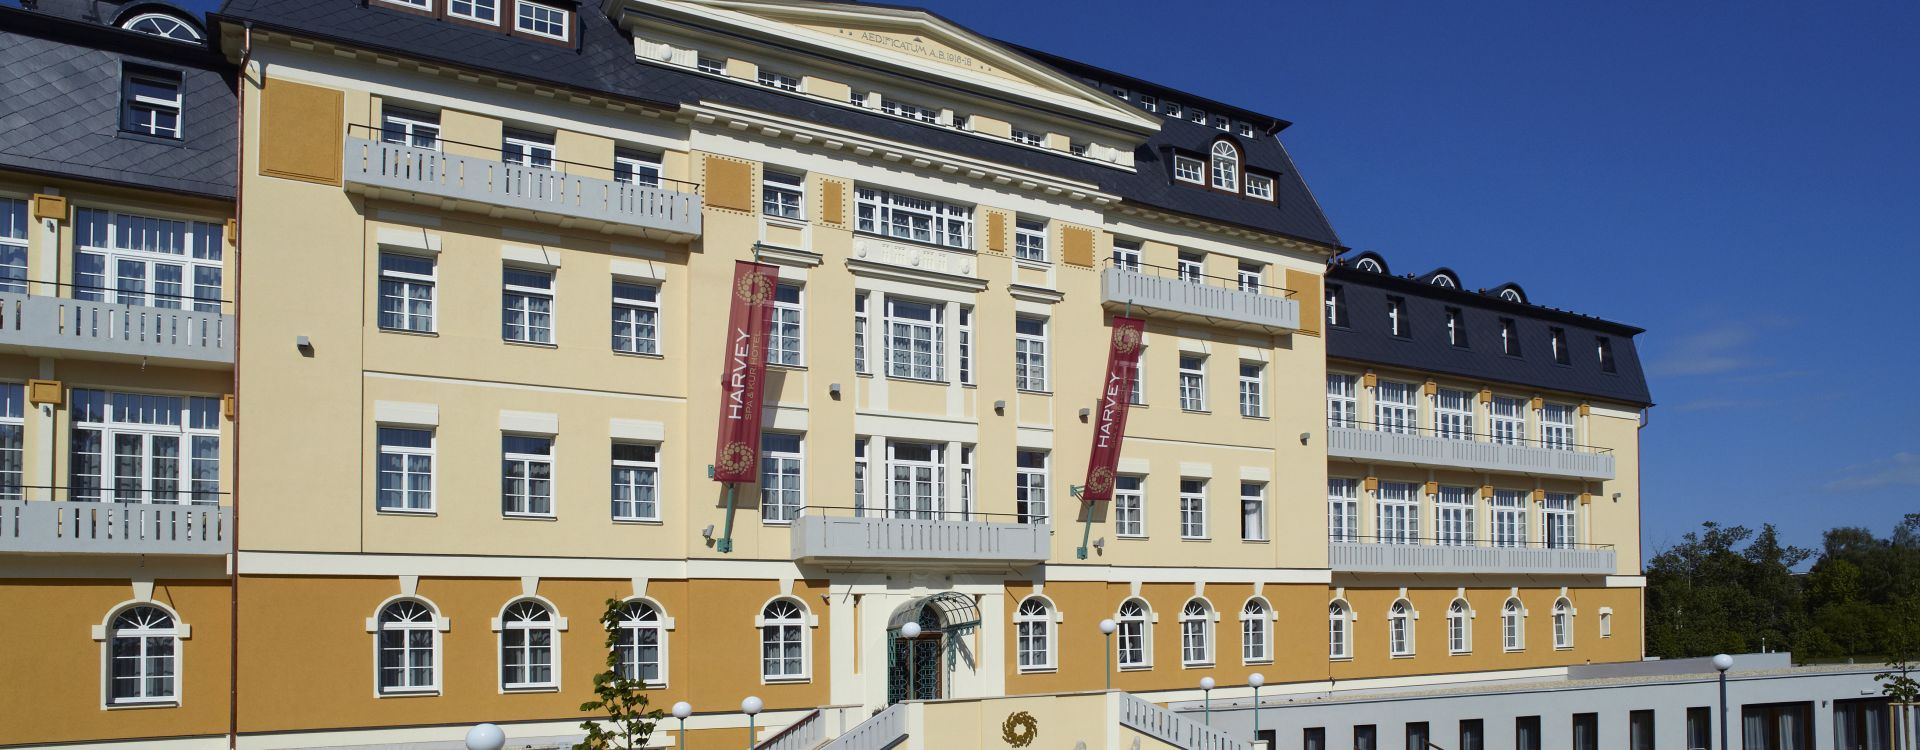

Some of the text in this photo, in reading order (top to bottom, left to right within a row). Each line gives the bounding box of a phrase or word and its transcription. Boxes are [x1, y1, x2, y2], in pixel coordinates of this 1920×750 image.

[861, 31, 927, 56] AEDIFICATUM
[728, 327, 751, 420] HARVEY
[744, 330, 761, 421] SPA & KUR HOTEL
[1097, 371, 1121, 448] HARVEY
